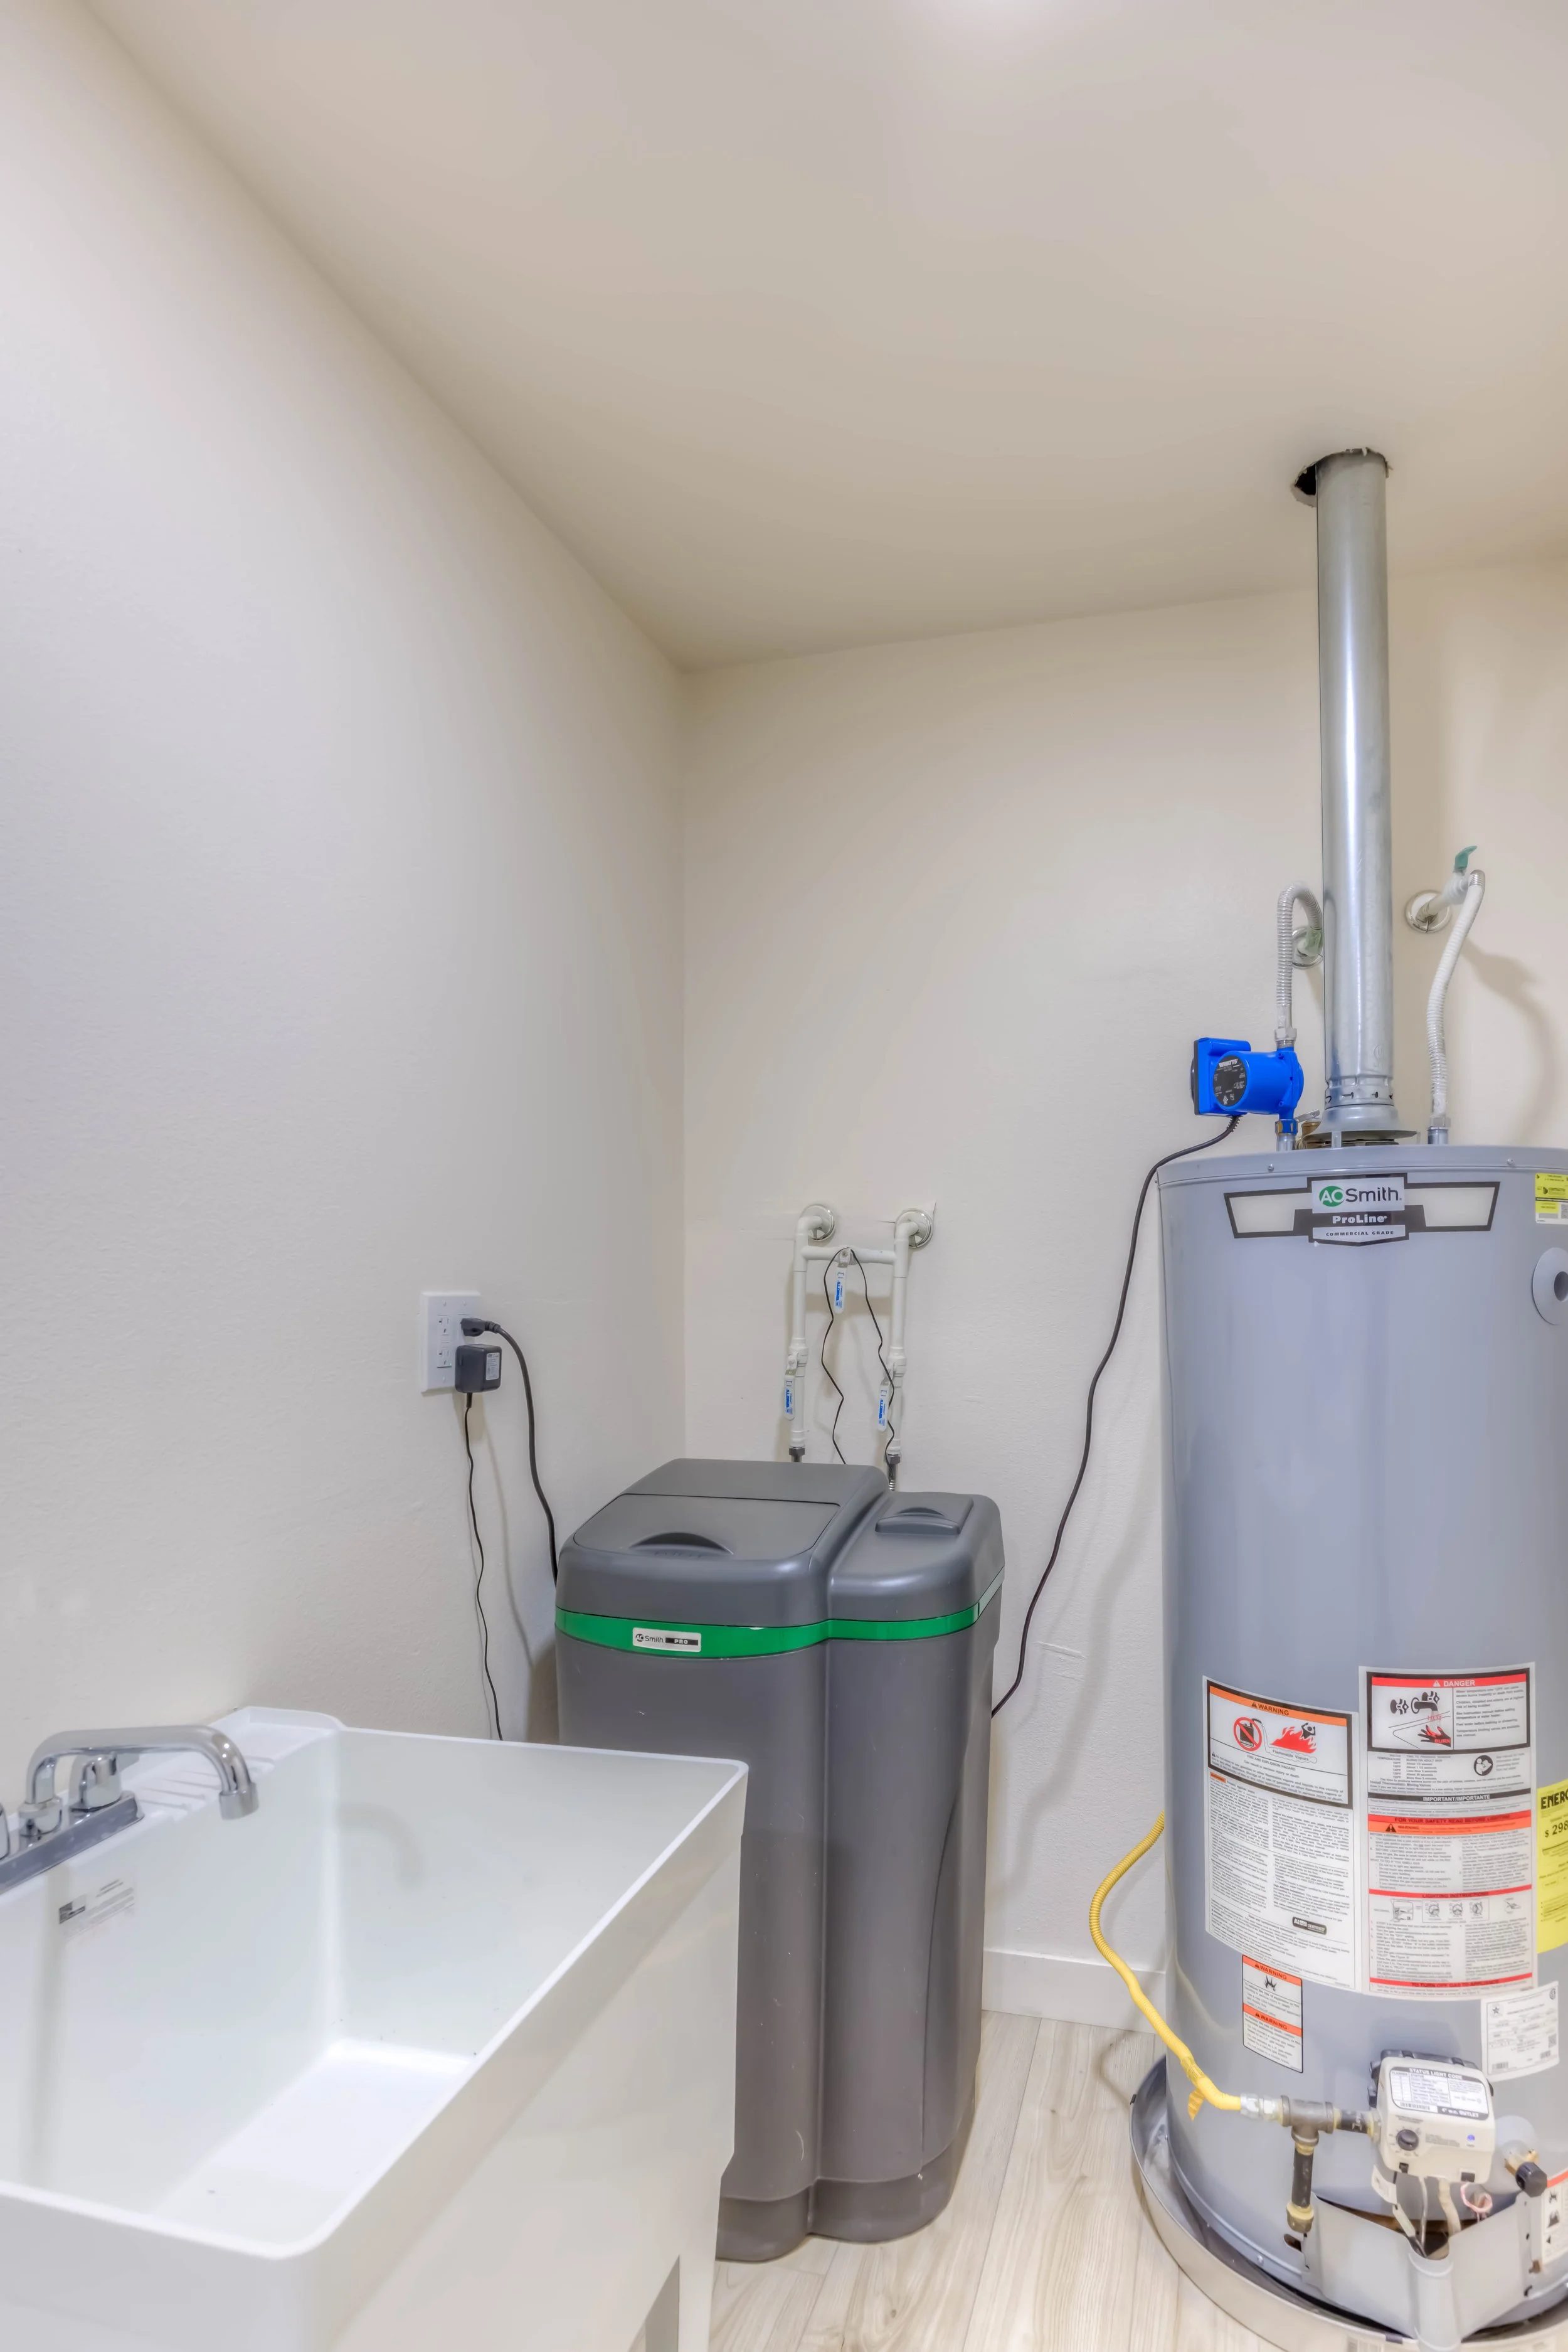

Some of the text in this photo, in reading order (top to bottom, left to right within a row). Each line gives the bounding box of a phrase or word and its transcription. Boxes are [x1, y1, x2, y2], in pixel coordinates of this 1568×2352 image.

[1258, 1703, 1290, 1716] WARNING
[1259, 1967, 1287, 1980] WARNING
[1260, 2014, 1287, 2030] WARNING
